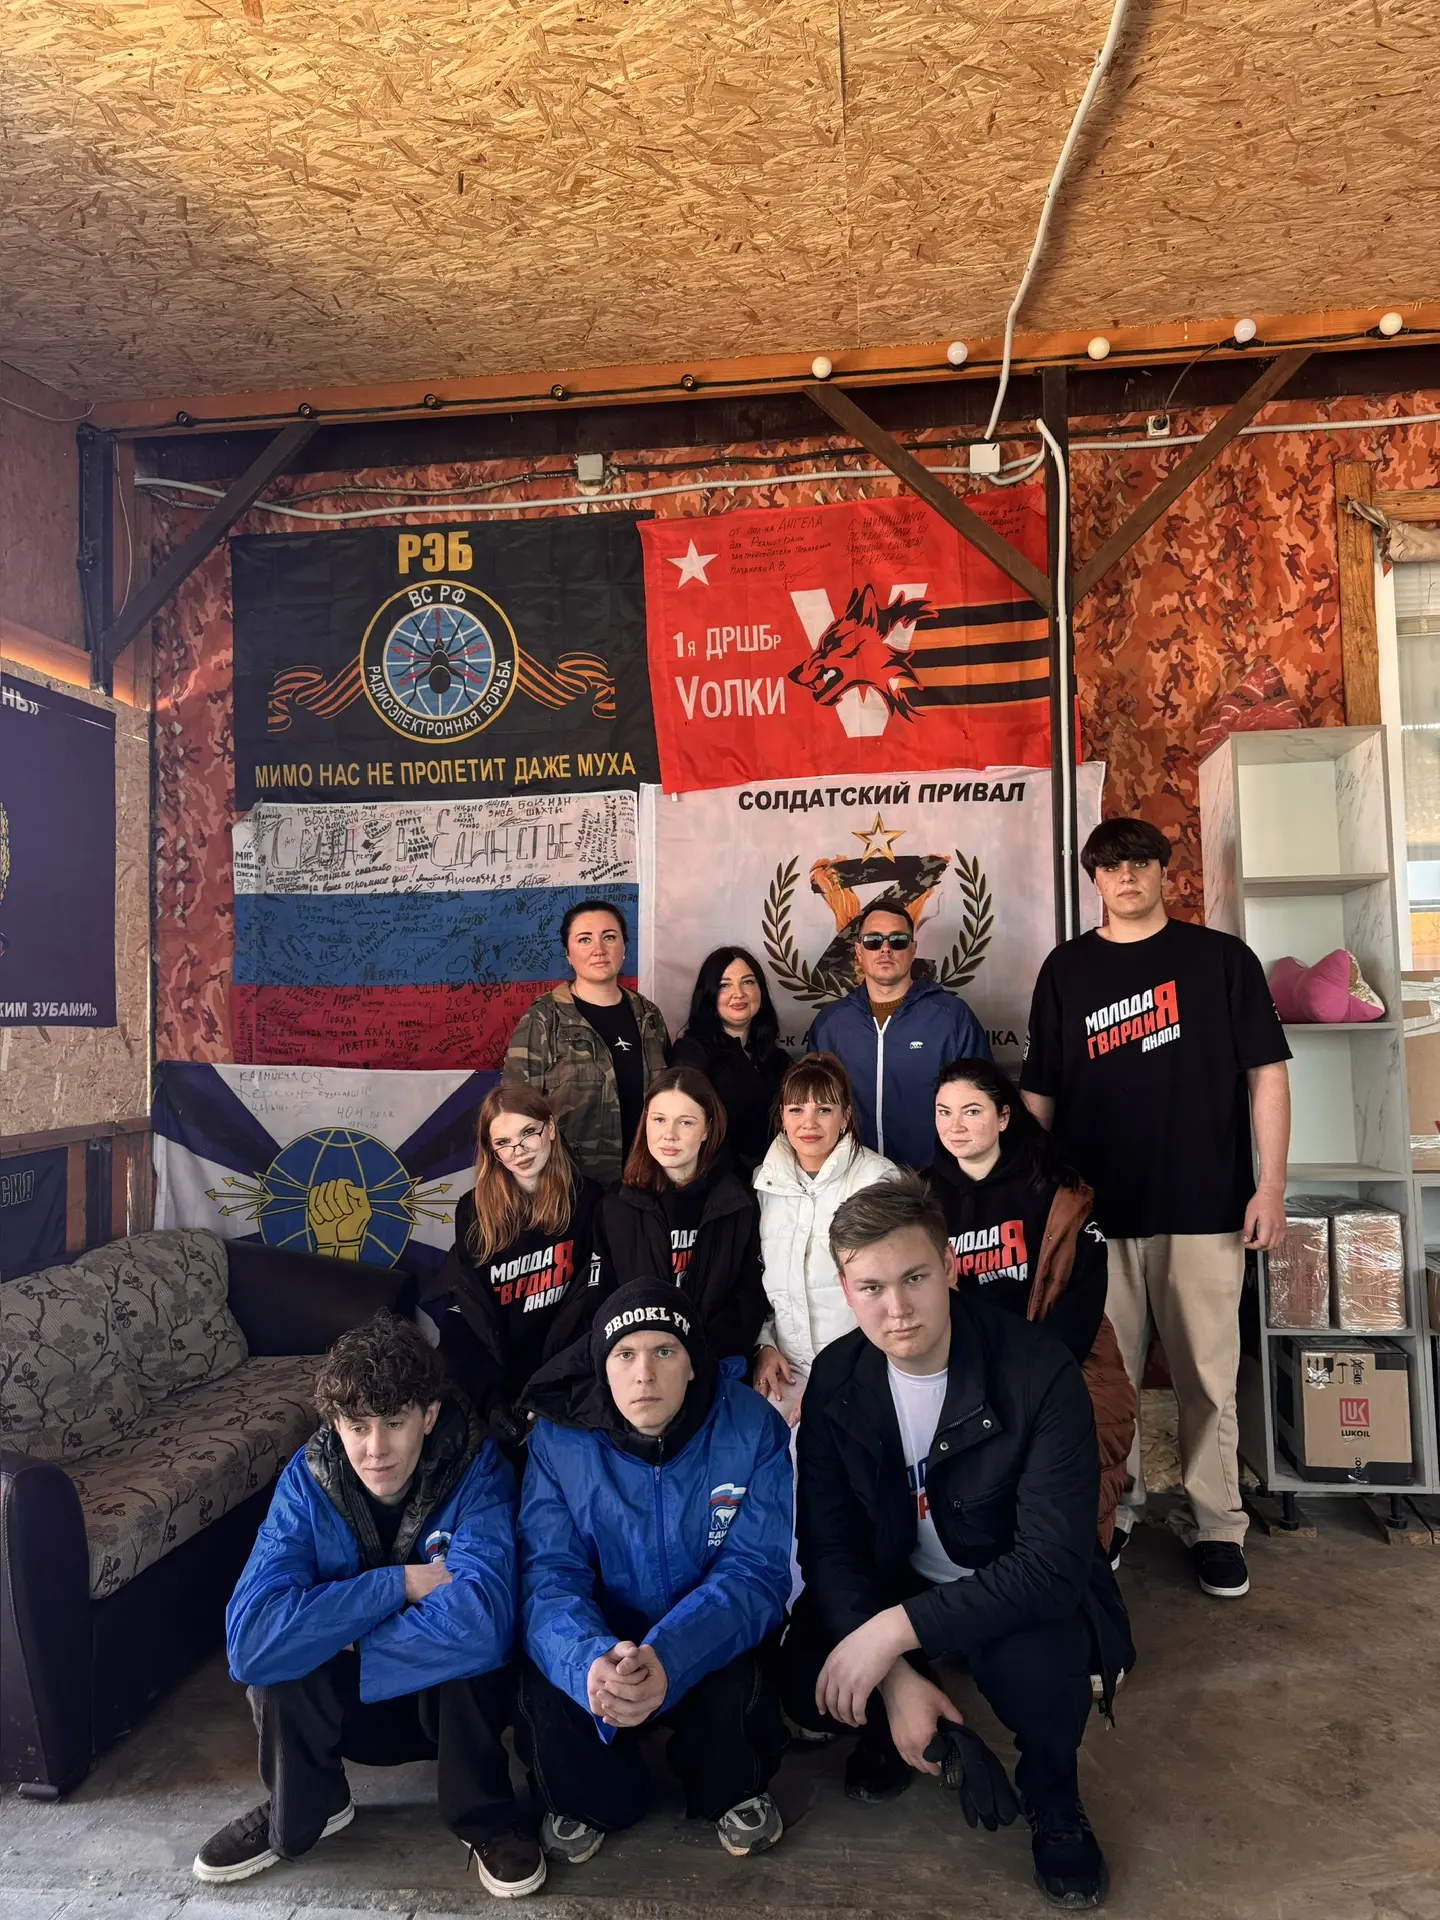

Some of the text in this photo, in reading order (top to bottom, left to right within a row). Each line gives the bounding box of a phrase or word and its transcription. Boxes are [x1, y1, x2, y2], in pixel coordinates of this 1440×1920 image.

[399, 531, 473, 574] РЭБ
[407, 585, 467, 608] ВС РФ
[367, 660, 512, 737] РАДИОЭЛЕКТРОННАЯ БОРЬБА
[255, 752, 636, 788] МИМО НАС НЕ ПРОЛЕТИТ ДАЖЕ МУХА
[739, 781, 1025, 812] СОЛДАТСКИЙ ПРИВАЛ
[32, 1002, 97, 1017] ЗУБАМИ!»
[1141, 1024, 1180, 1052] АНАПА
[604, 1307, 690, 1339] BROOKLYN
